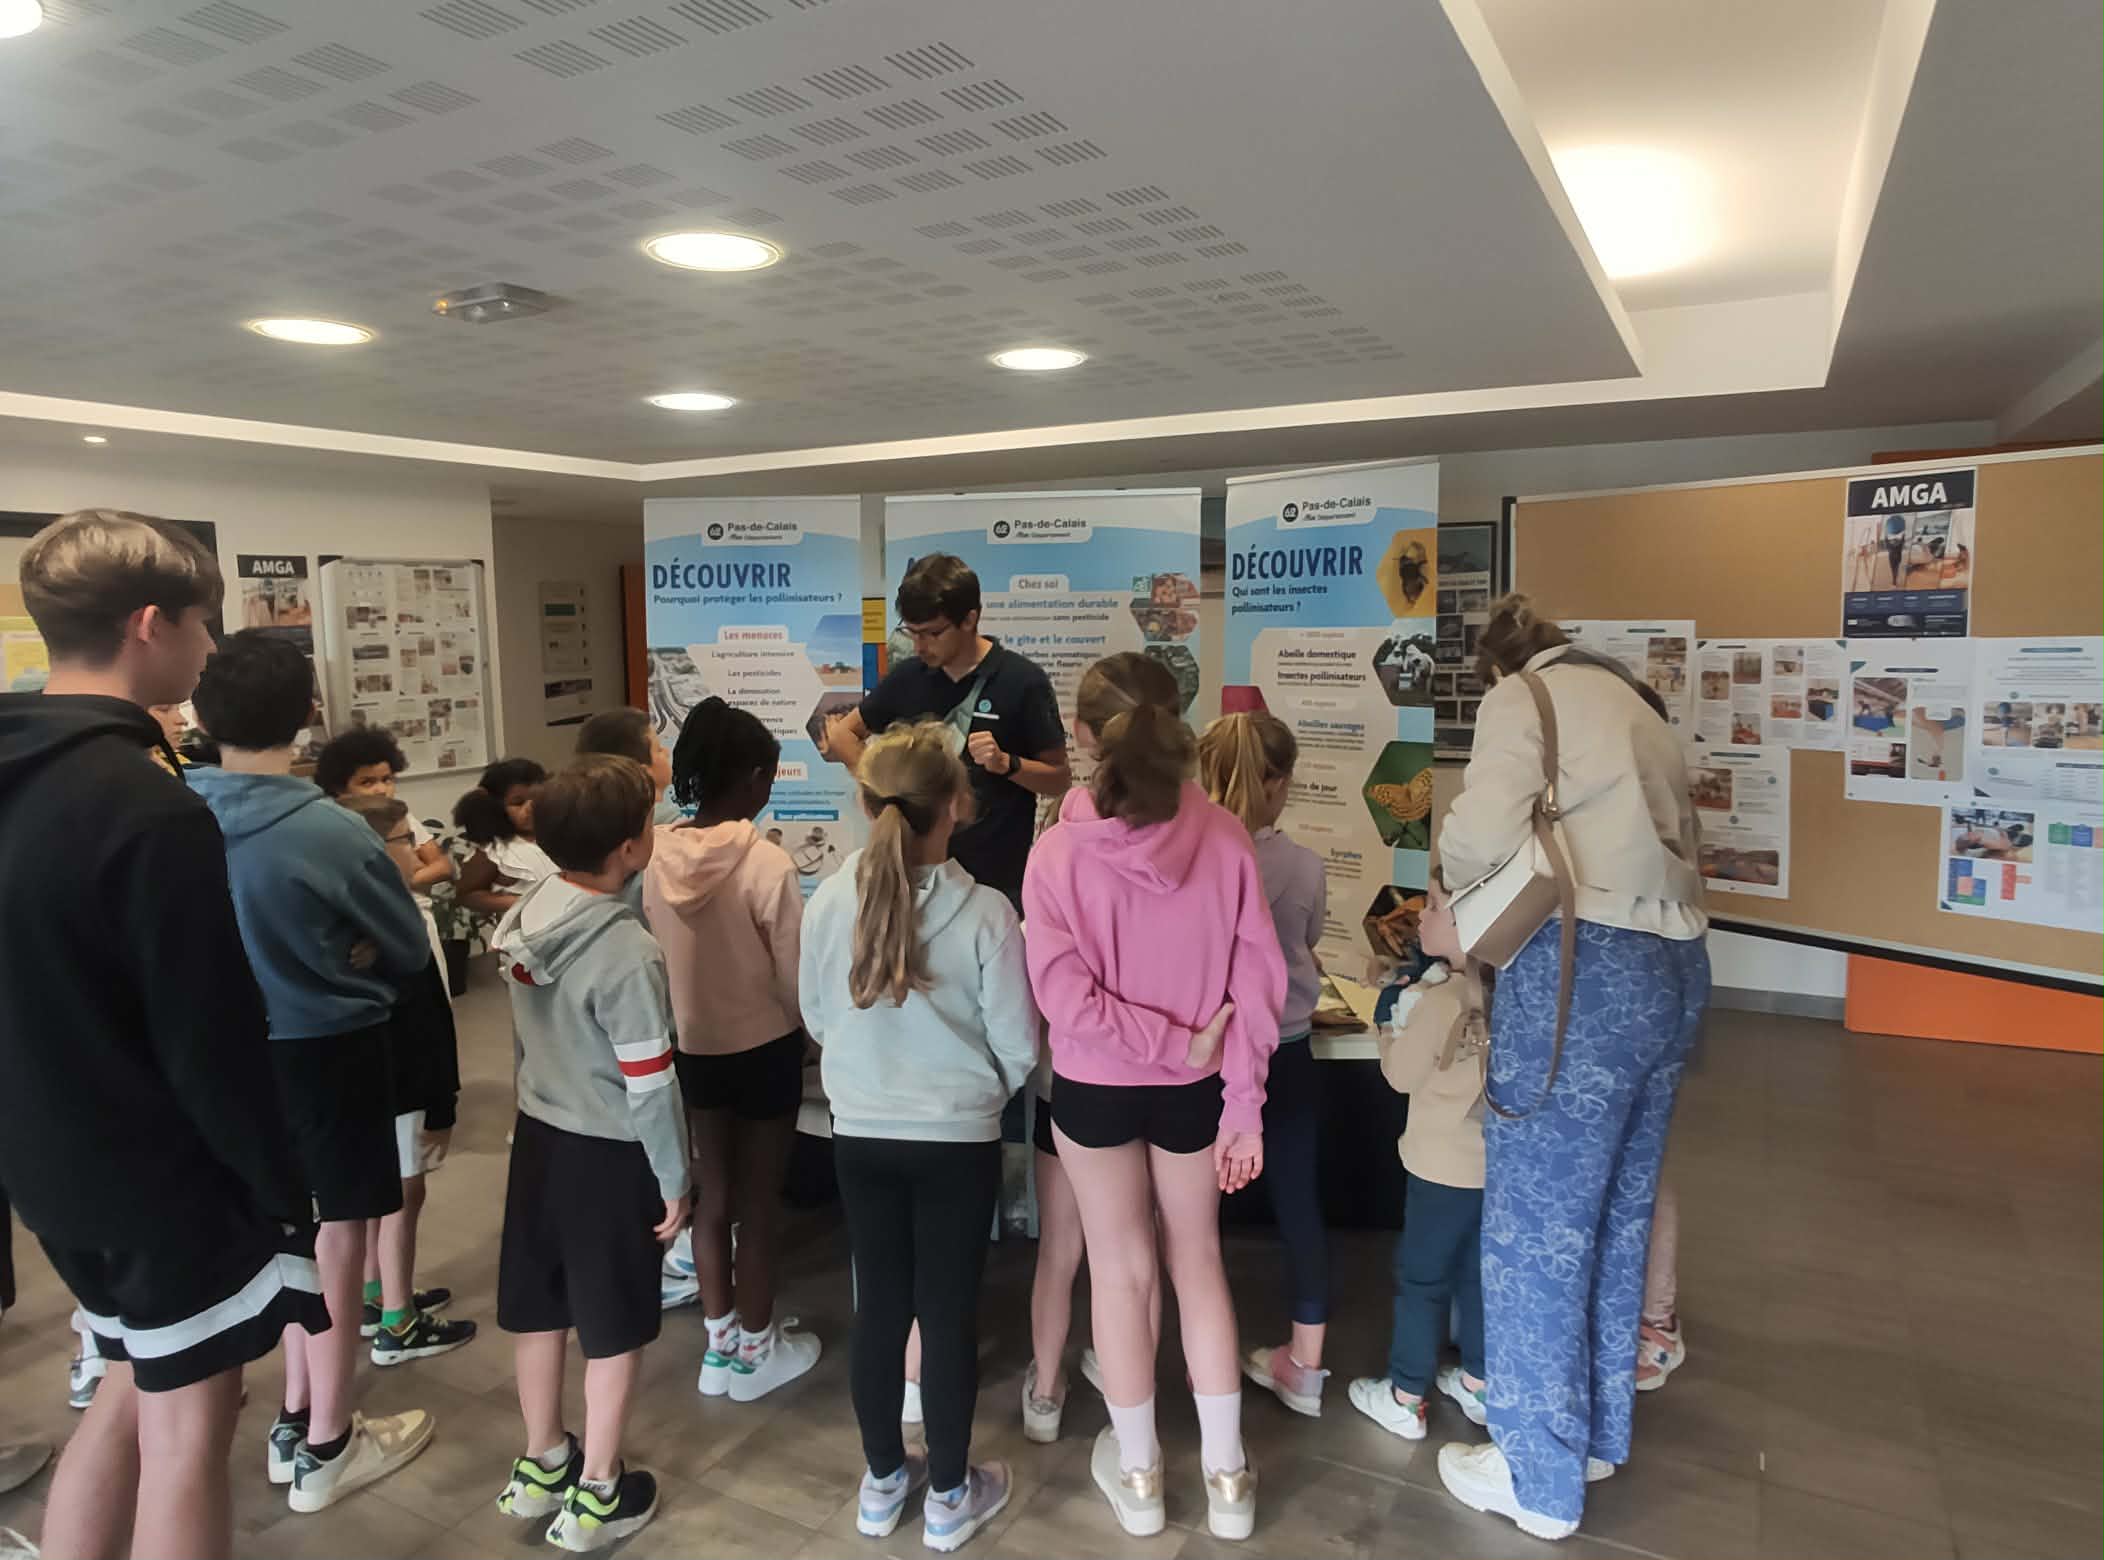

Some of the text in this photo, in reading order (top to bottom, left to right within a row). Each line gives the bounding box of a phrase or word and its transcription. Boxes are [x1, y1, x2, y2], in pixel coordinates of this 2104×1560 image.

[1871, 482, 1947, 509] AMGA
[1302, 497, 1371, 510] Pas-de-Calais
[728, 522, 798, 532] Pas-de-Calais
[1014, 519, 1086, 529] Pas-de-Calais
[252, 560, 295, 575] AMGA
[1232, 544, 1363, 580] DÉCOUVRIR
[652, 557, 791, 589] DÉCOUVRIR
[1018, 578, 1041, 589] Chez
[1232, 584, 1327, 598] Qui sont les insectes
[653, 594, 700, 606] Pourquoi
[749, 593, 763, 603] les
[766, 592, 835, 605] pollinisateurs
[1008, 599, 1075, 609] alimentation
[1078, 598, 1118, 608] durable
[1232, 602, 1294, 616] pollinisateurs
[724, 631, 783, 640] Les menaces
[1053, 633, 1062, 643] le
[1065, 635, 1105, 644] couvert
[1279, 648, 1357, 661] Abeille domestique
[1278, 671, 1366, 684] Insectes pollinisateurs
